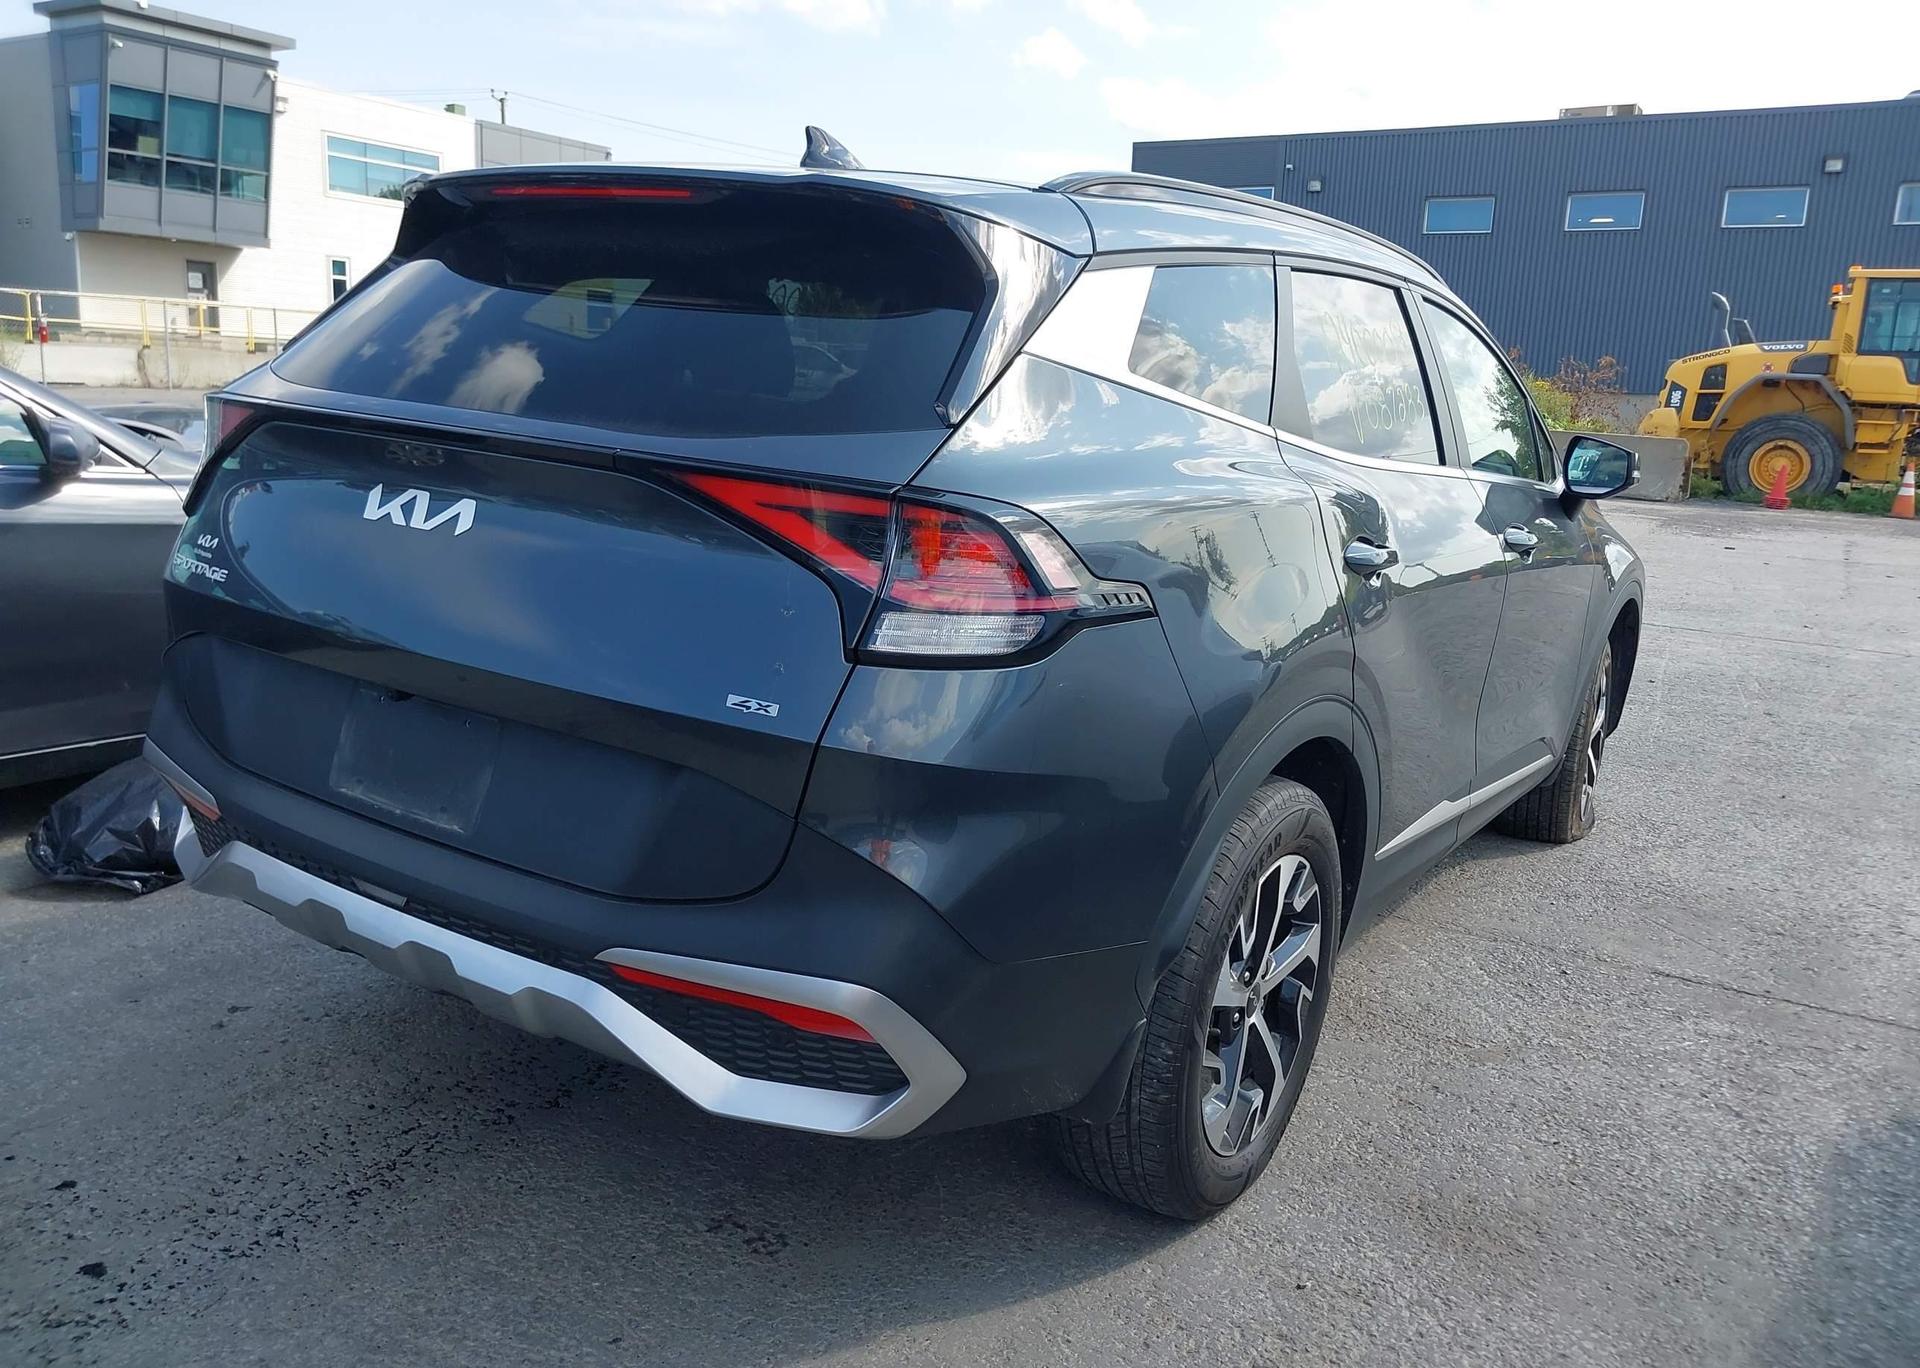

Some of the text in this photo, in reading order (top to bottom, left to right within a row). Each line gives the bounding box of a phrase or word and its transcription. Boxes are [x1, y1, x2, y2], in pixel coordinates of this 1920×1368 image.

[1763, 343, 1805, 351] VOLVO
[1681, 349, 1731, 364] STRONGCO
[363, 483, 477, 536] KIA
[197, 533, 219, 549] KIA
[173, 553, 229, 582] SPORTAGE
